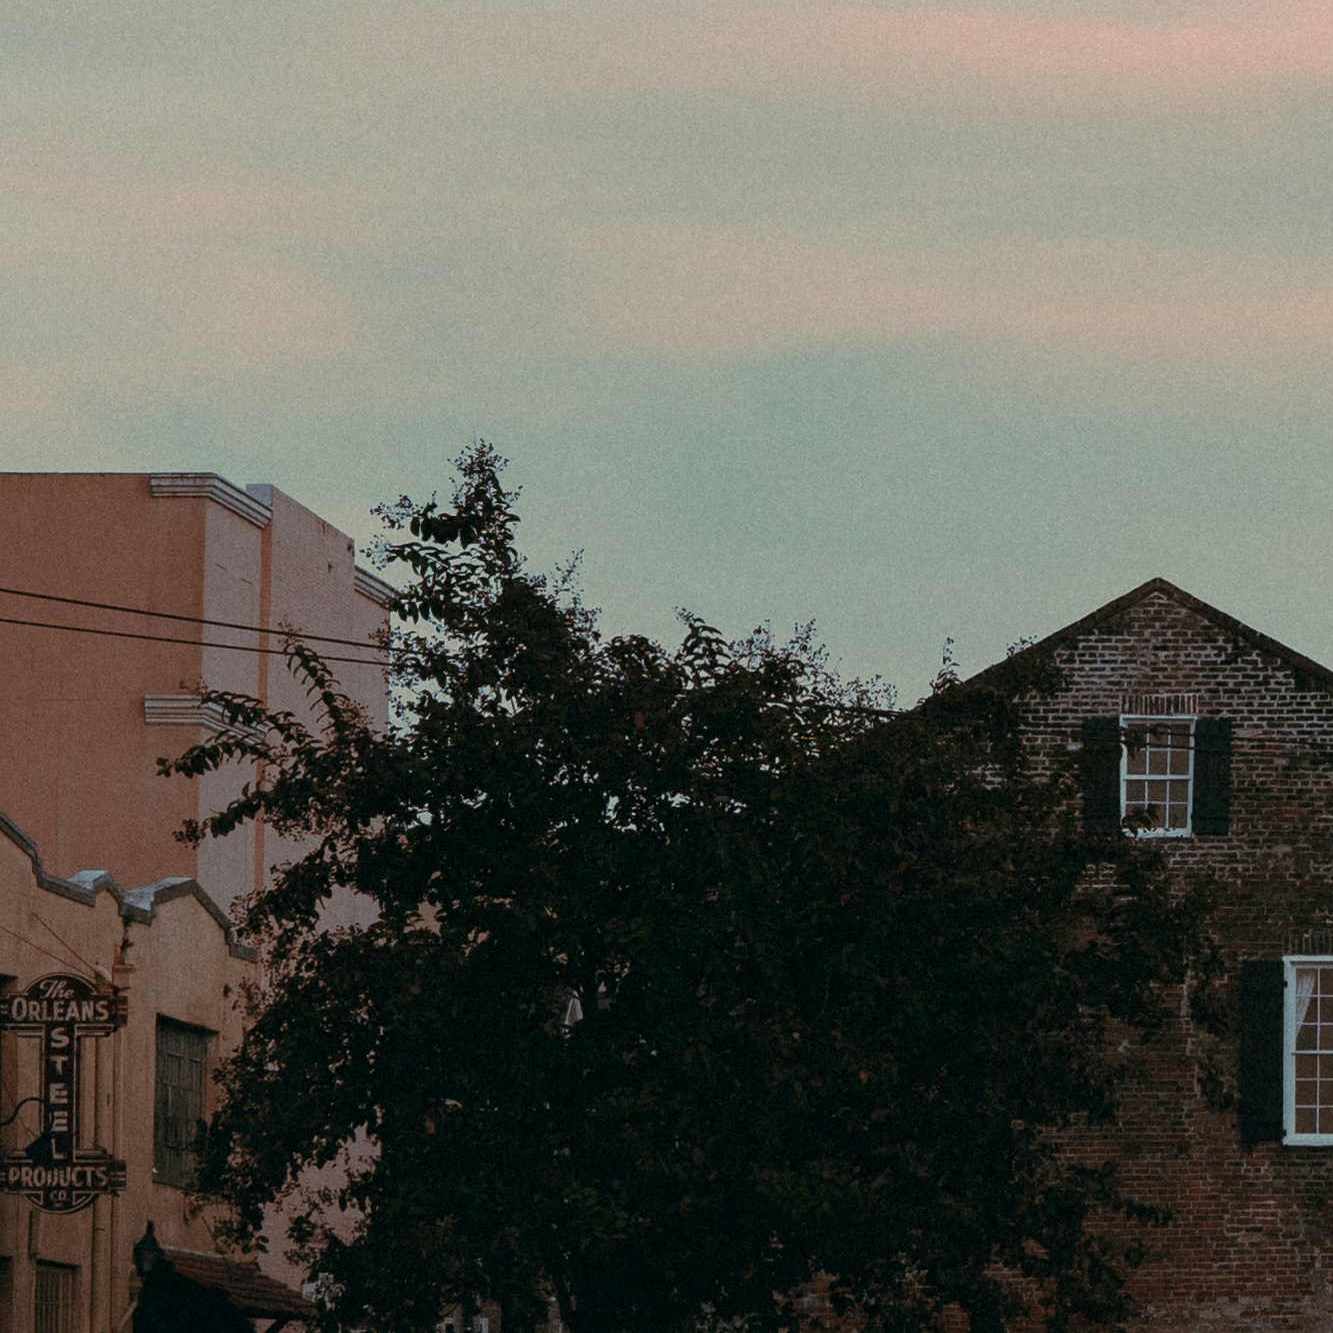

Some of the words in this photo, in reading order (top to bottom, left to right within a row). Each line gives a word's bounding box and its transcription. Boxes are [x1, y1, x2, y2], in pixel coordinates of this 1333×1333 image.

[39, 979, 75, 1000] The
[11, 997, 110, 1022] ORLEANS
[49, 1027, 70, 1160] STEEL
[8, 1166, 109, 1187] PRODUCTS
